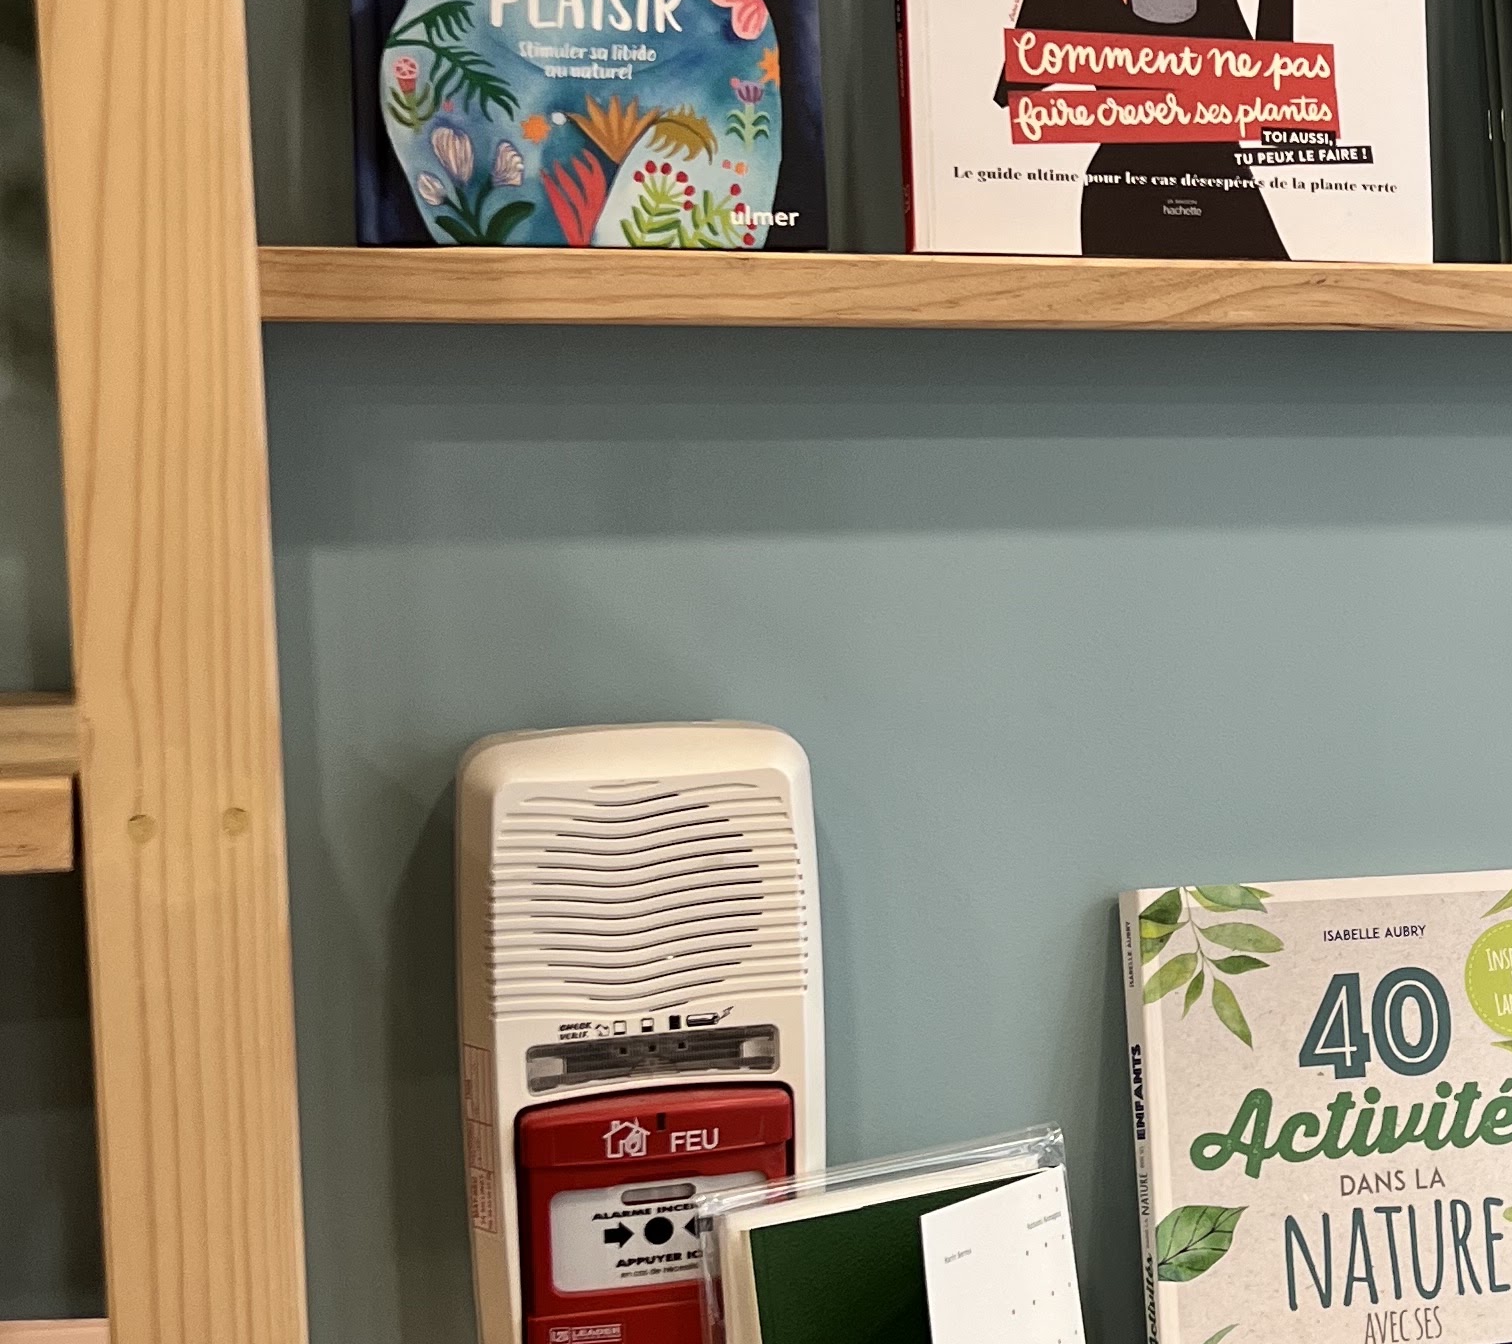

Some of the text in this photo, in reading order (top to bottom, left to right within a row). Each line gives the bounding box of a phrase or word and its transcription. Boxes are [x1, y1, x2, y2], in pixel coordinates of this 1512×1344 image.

[519, 41, 586, 61] Stimuler
[612, 43, 657, 62] libido
[1013, 31, 1331, 90] Comment ne pas
[1013, 94, 1332, 141] faire crever ses plantes
[1263, 130, 1334, 147] TOI AUSSI,
[1234, 153, 1251, 166] TU
[1258, 151, 1295, 165] PEUX
[1299, 149, 1315, 162] LE
[1319, 148, 1358, 161] FAIRE
[954, 166, 1398, 194] Le guide ultime pour les cas désespérés de la plante verte
[730, 206, 799, 228] ulmer
[1163, 204, 1202, 217] hachette
[1323, 925, 1426, 942] ISABELLE AUBRY
[1299, 967, 1452, 1080] 40
[670, 1127, 719, 1152] FEU
[1340, 1166, 1445, 1196] DANS LA
[592, 1207, 651, 1221] ALARME
[616, 1251, 683, 1268] APPUYER
[1284, 1197, 1511, 1311] NATURE
[1416, 1306, 1443, 1339] SES
